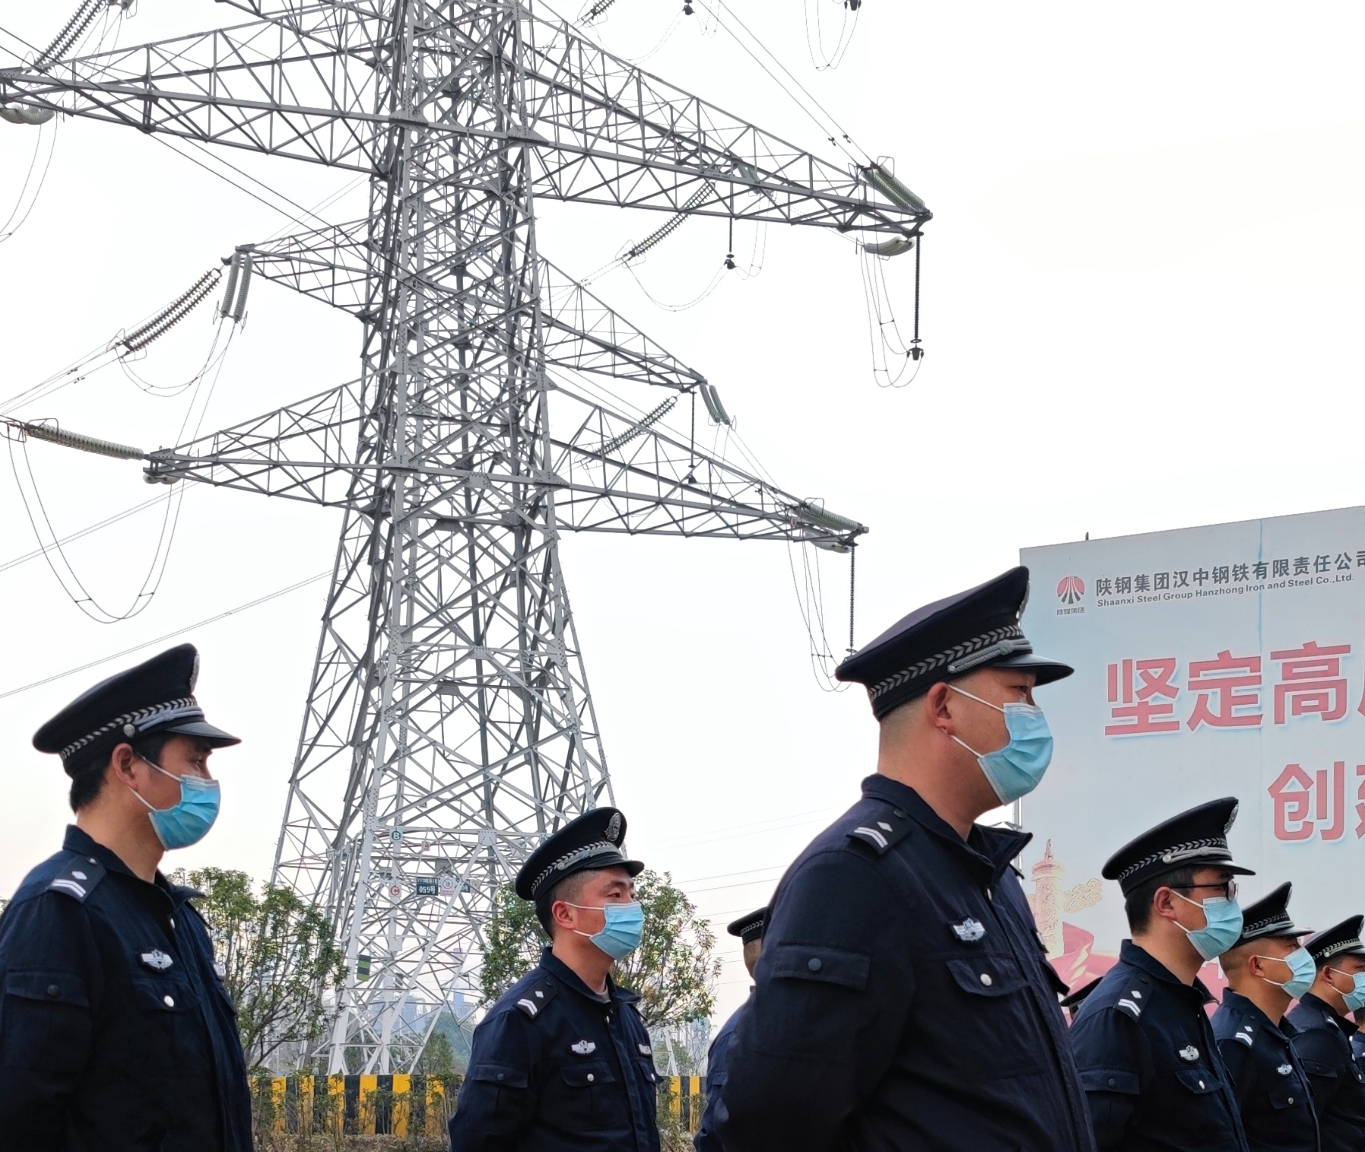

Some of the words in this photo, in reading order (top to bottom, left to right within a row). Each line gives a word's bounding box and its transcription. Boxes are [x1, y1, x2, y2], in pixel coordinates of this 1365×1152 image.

[1097, 596, 1135, 608] Shaanxi
[1136, 593, 1161, 604] Steel
[1163, 590, 1193, 601] Group
[1195, 585, 1244, 598] Hanzhong
[1246, 583, 1265, 593] Iron
[1267, 580, 1286, 590] and
[1287, 577, 1313, 588] Steel
